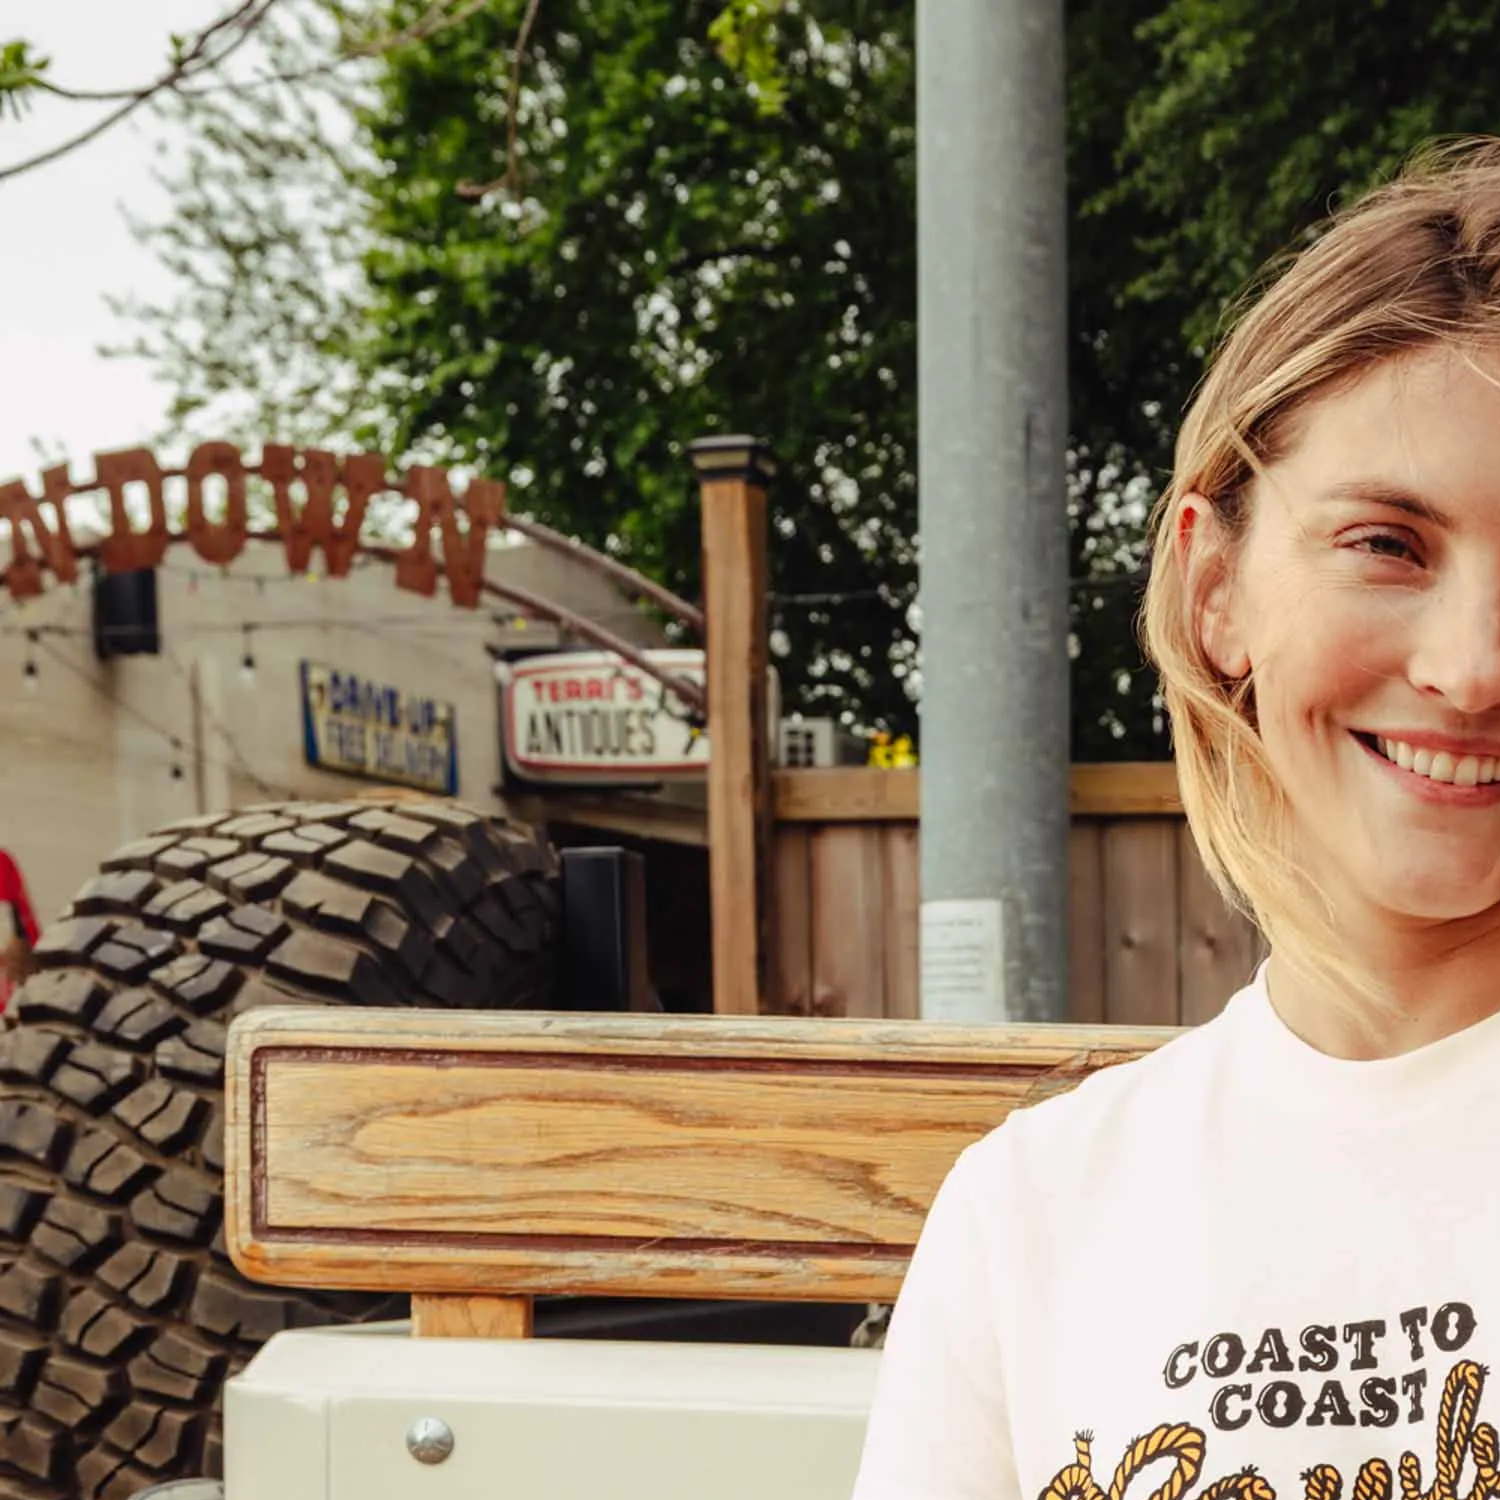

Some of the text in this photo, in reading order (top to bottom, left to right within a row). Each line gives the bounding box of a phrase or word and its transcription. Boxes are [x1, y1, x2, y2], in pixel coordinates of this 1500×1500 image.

[526, 710, 655, 755] ANTIQUES
[1163, 1302, 1478, 1389] COAST TO
[1208, 1368, 1428, 1431] COAST
